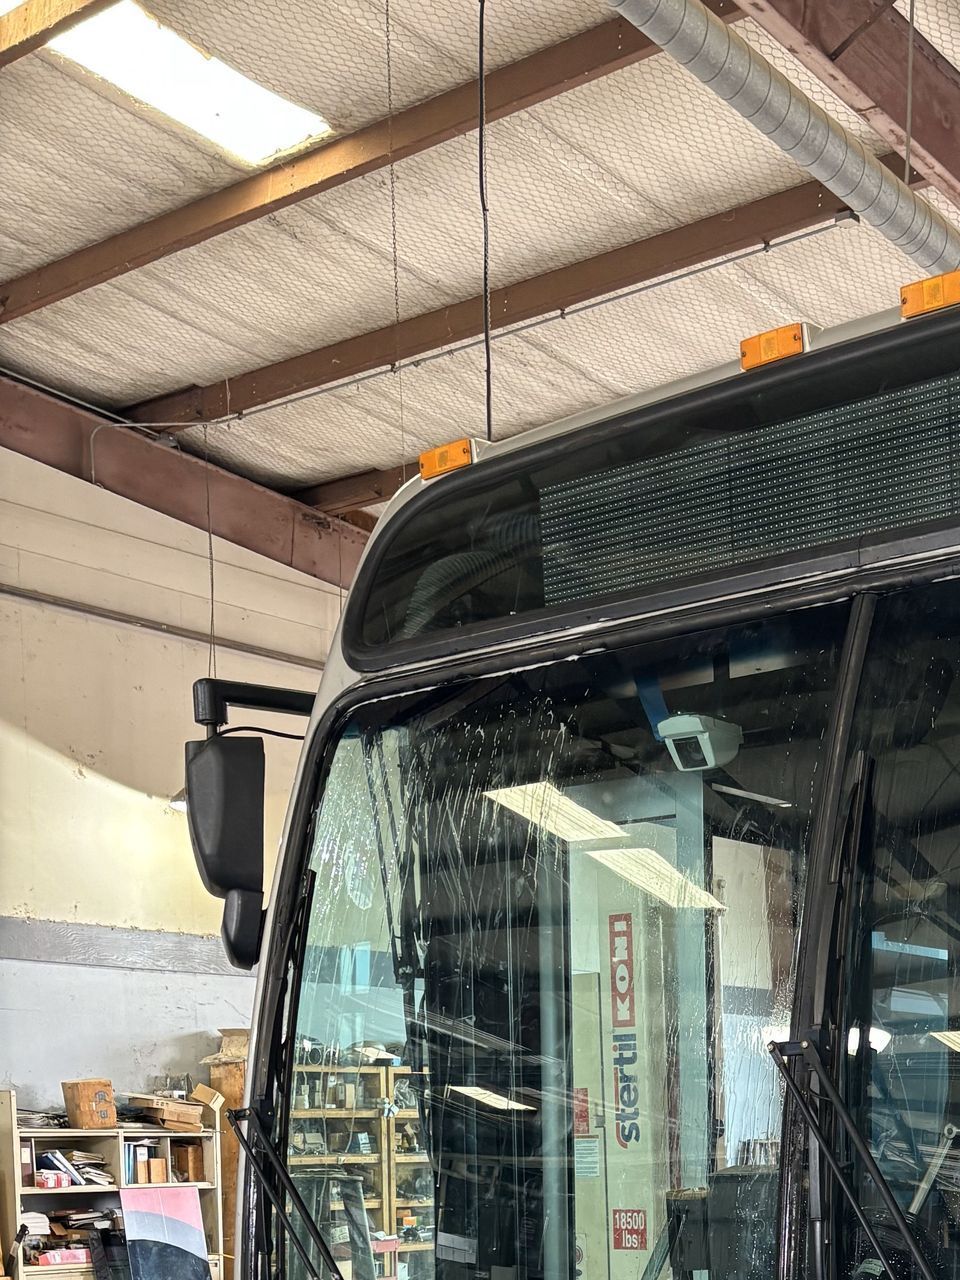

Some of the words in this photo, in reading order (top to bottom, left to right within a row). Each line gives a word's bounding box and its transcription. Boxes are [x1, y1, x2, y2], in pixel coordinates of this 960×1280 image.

[613, 920, 632, 1022] KONI
[613, 1033, 640, 1148] stertil
[614, 1211, 645, 1230] 18500
[621, 1230, 639, 1248] lbs
